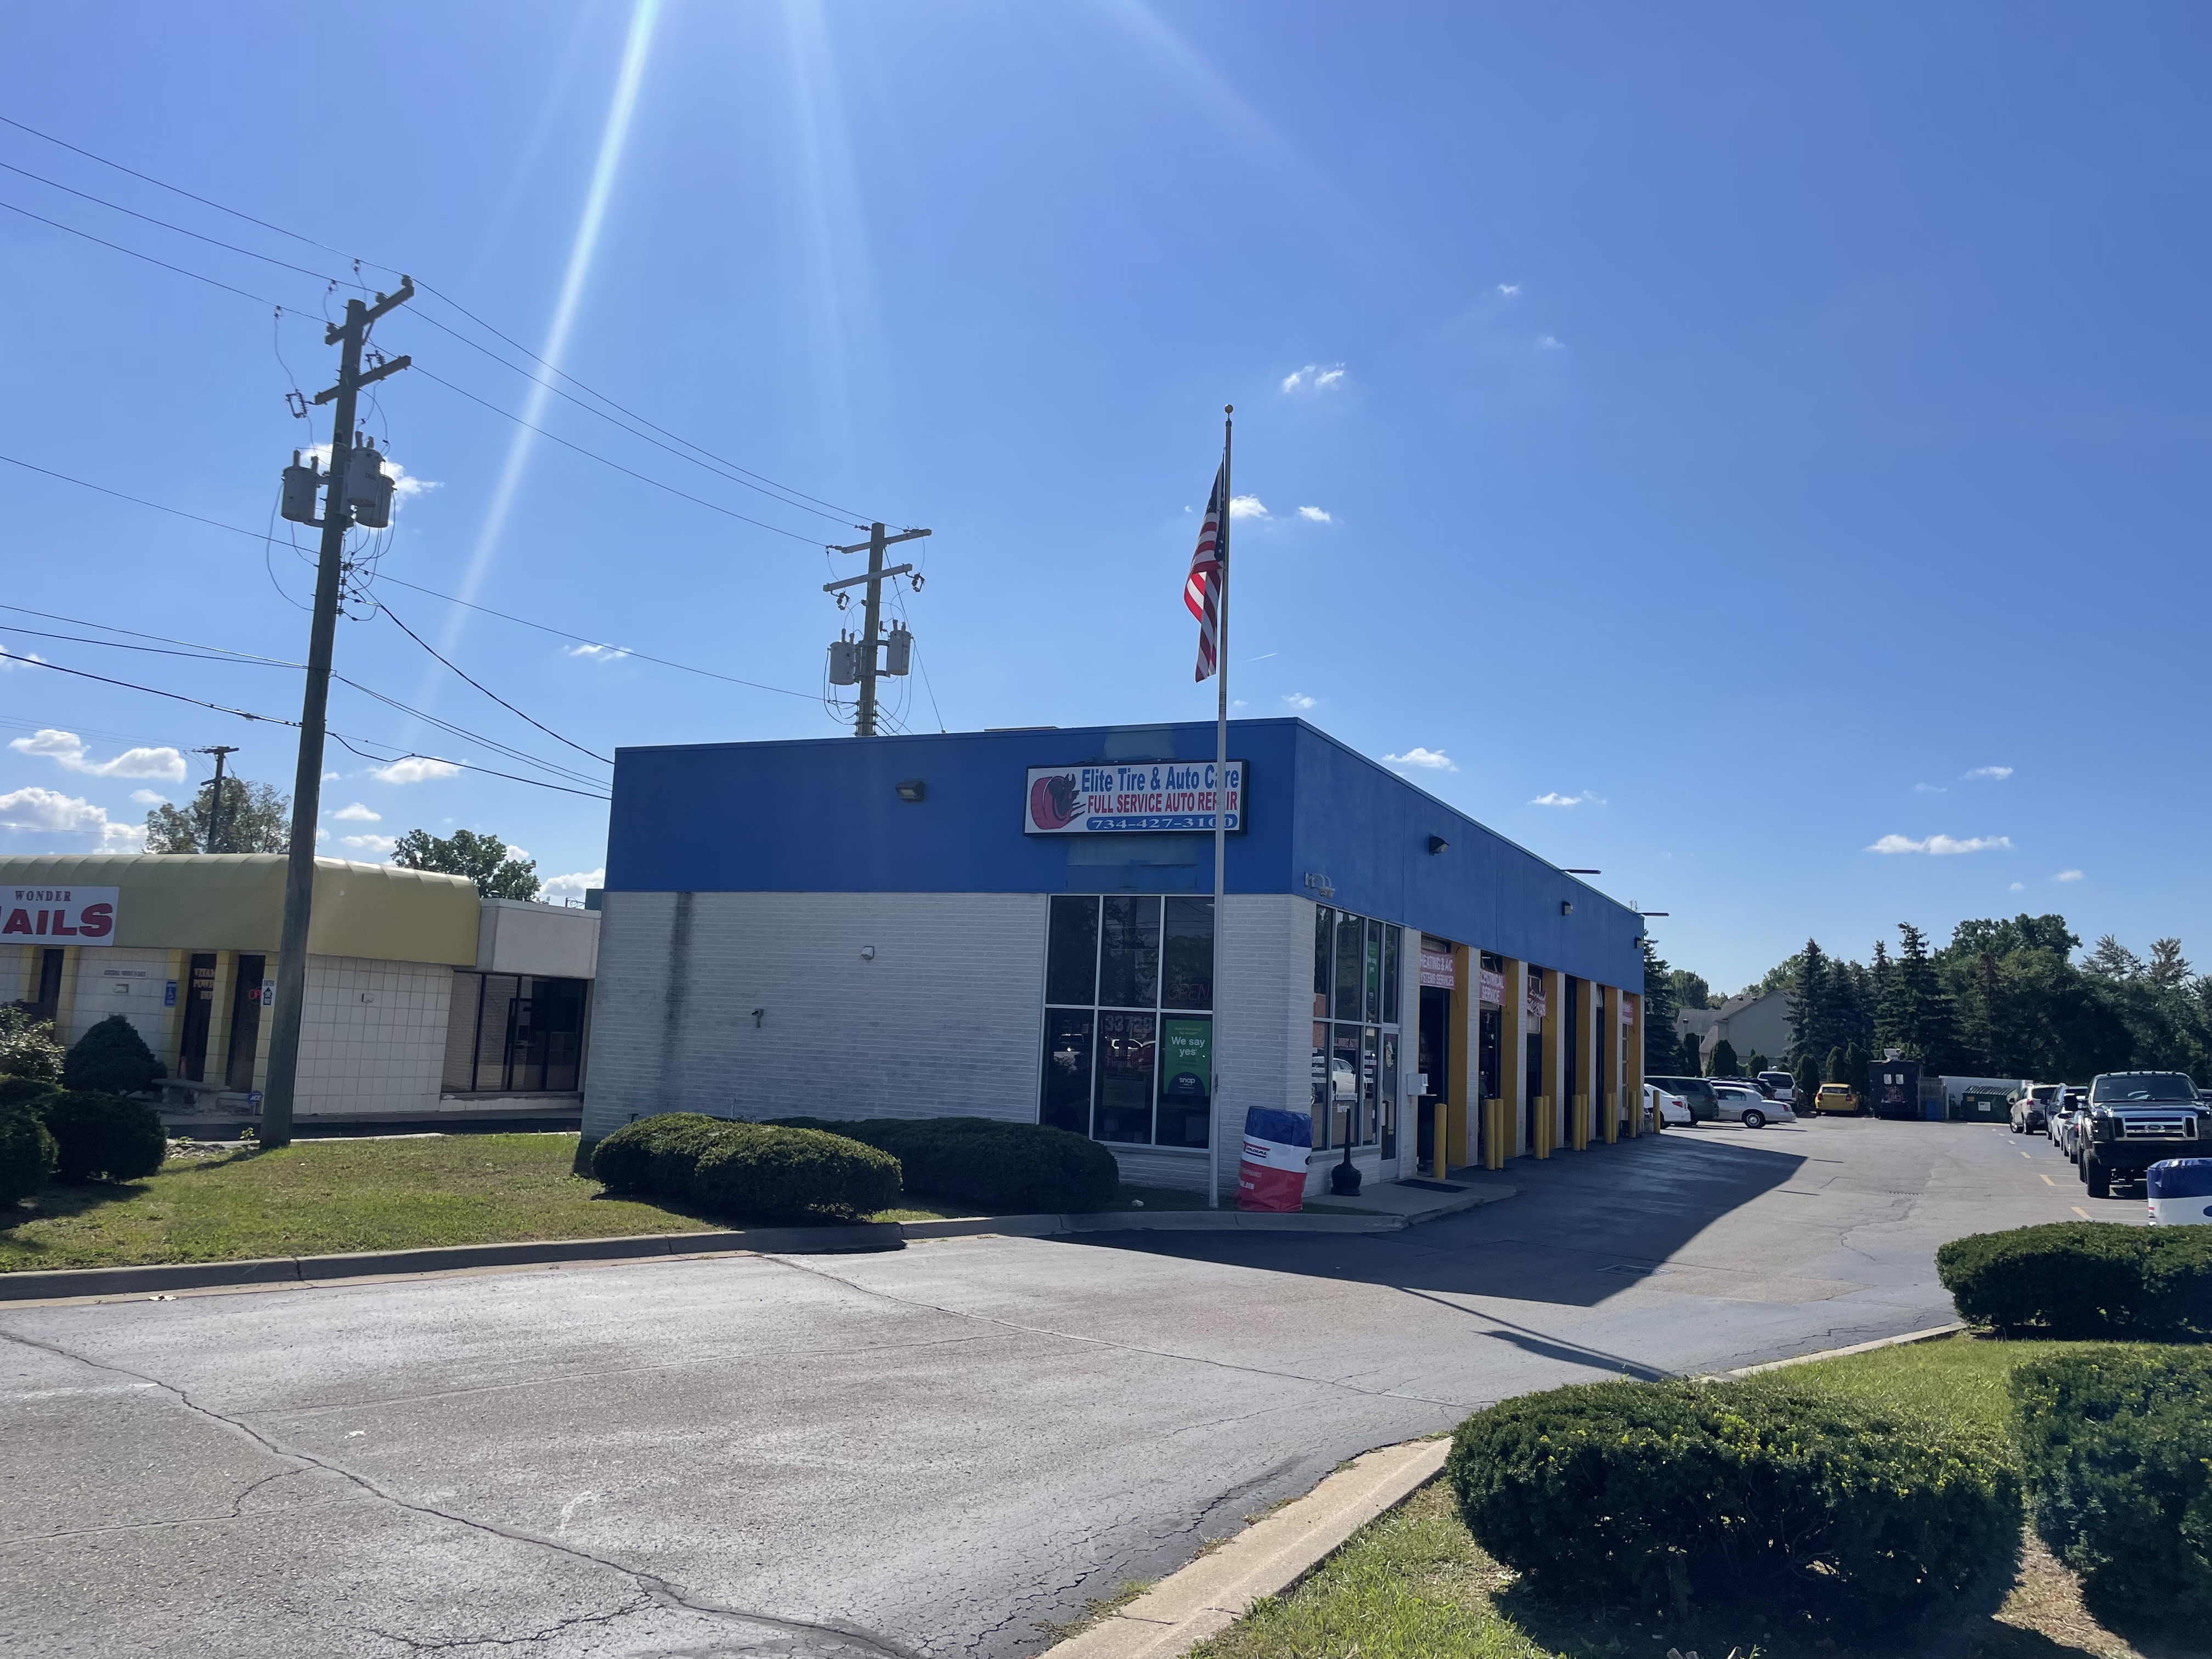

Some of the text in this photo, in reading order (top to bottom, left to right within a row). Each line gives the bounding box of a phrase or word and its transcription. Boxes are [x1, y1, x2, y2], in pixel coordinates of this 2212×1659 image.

[1081, 769, 1113, 792] Elite
[1118, 768, 1146, 791] Tire
[1150, 766, 1160, 791] &
[1165, 766, 1199, 790] Auto
[1087, 791, 1238, 814] FULL SERVICE AUTO REPIR
[1092, 817, 1233, 830] 734-427-3100
[15, 890, 71, 901] WONDER
[0, 903, 113, 937] AILS
[1167, 983, 1210, 1001] OPEN
[1171, 1036, 1205, 1048] We say
